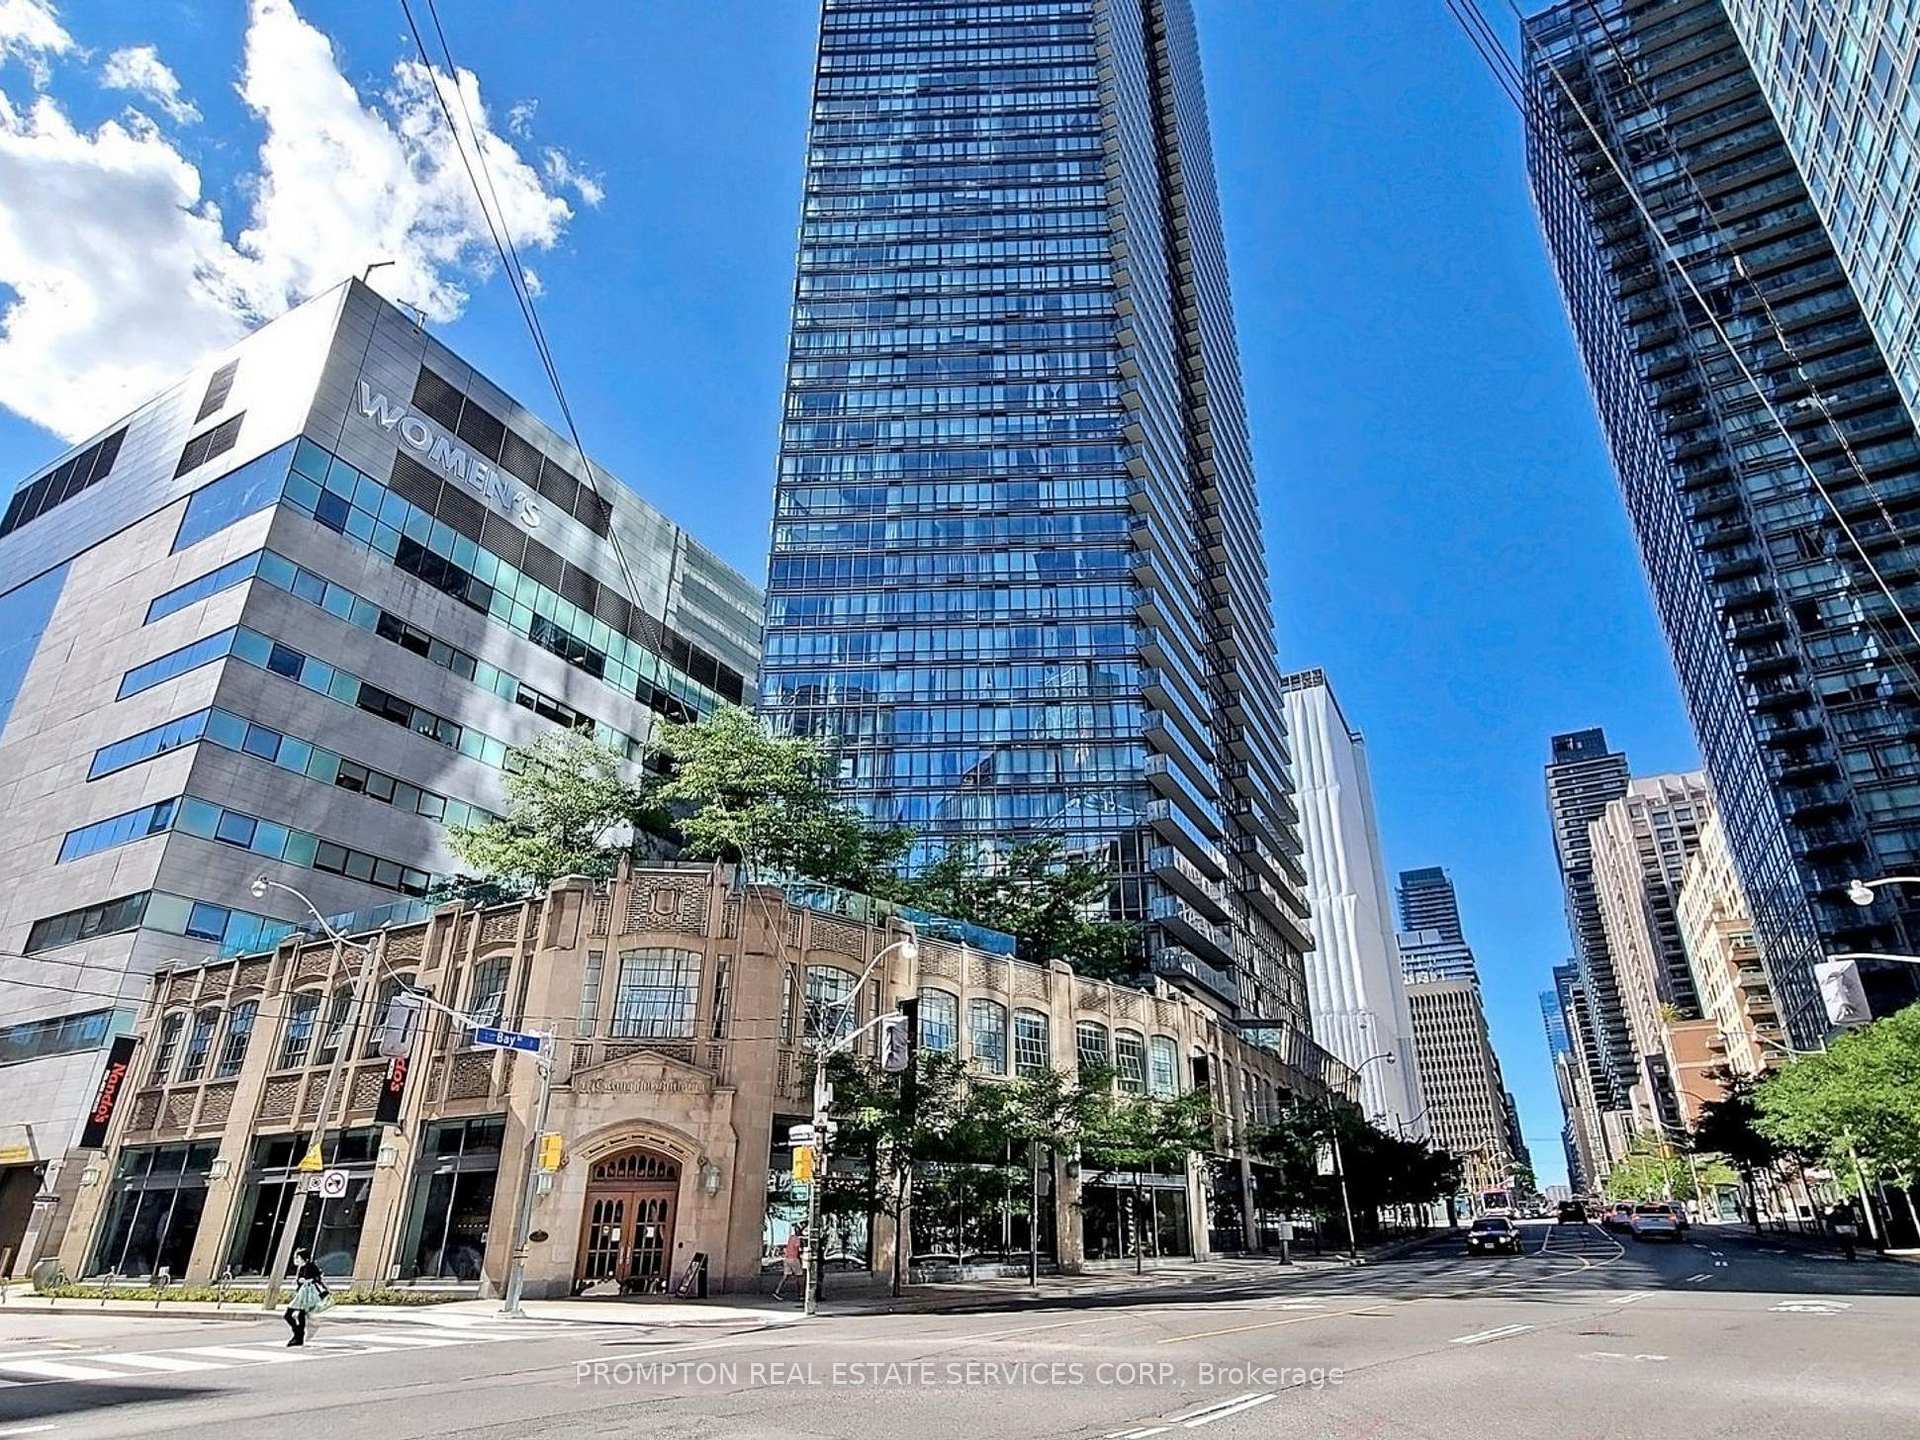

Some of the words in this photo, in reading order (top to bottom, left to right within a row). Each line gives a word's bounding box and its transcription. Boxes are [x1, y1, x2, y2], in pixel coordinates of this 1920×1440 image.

[357, 378, 542, 528] WOMEN'S
[496, 1032, 516, 1047] Bay
[94, 1063, 127, 1123] Nando's
[390, 1055, 407, 1092] do's
